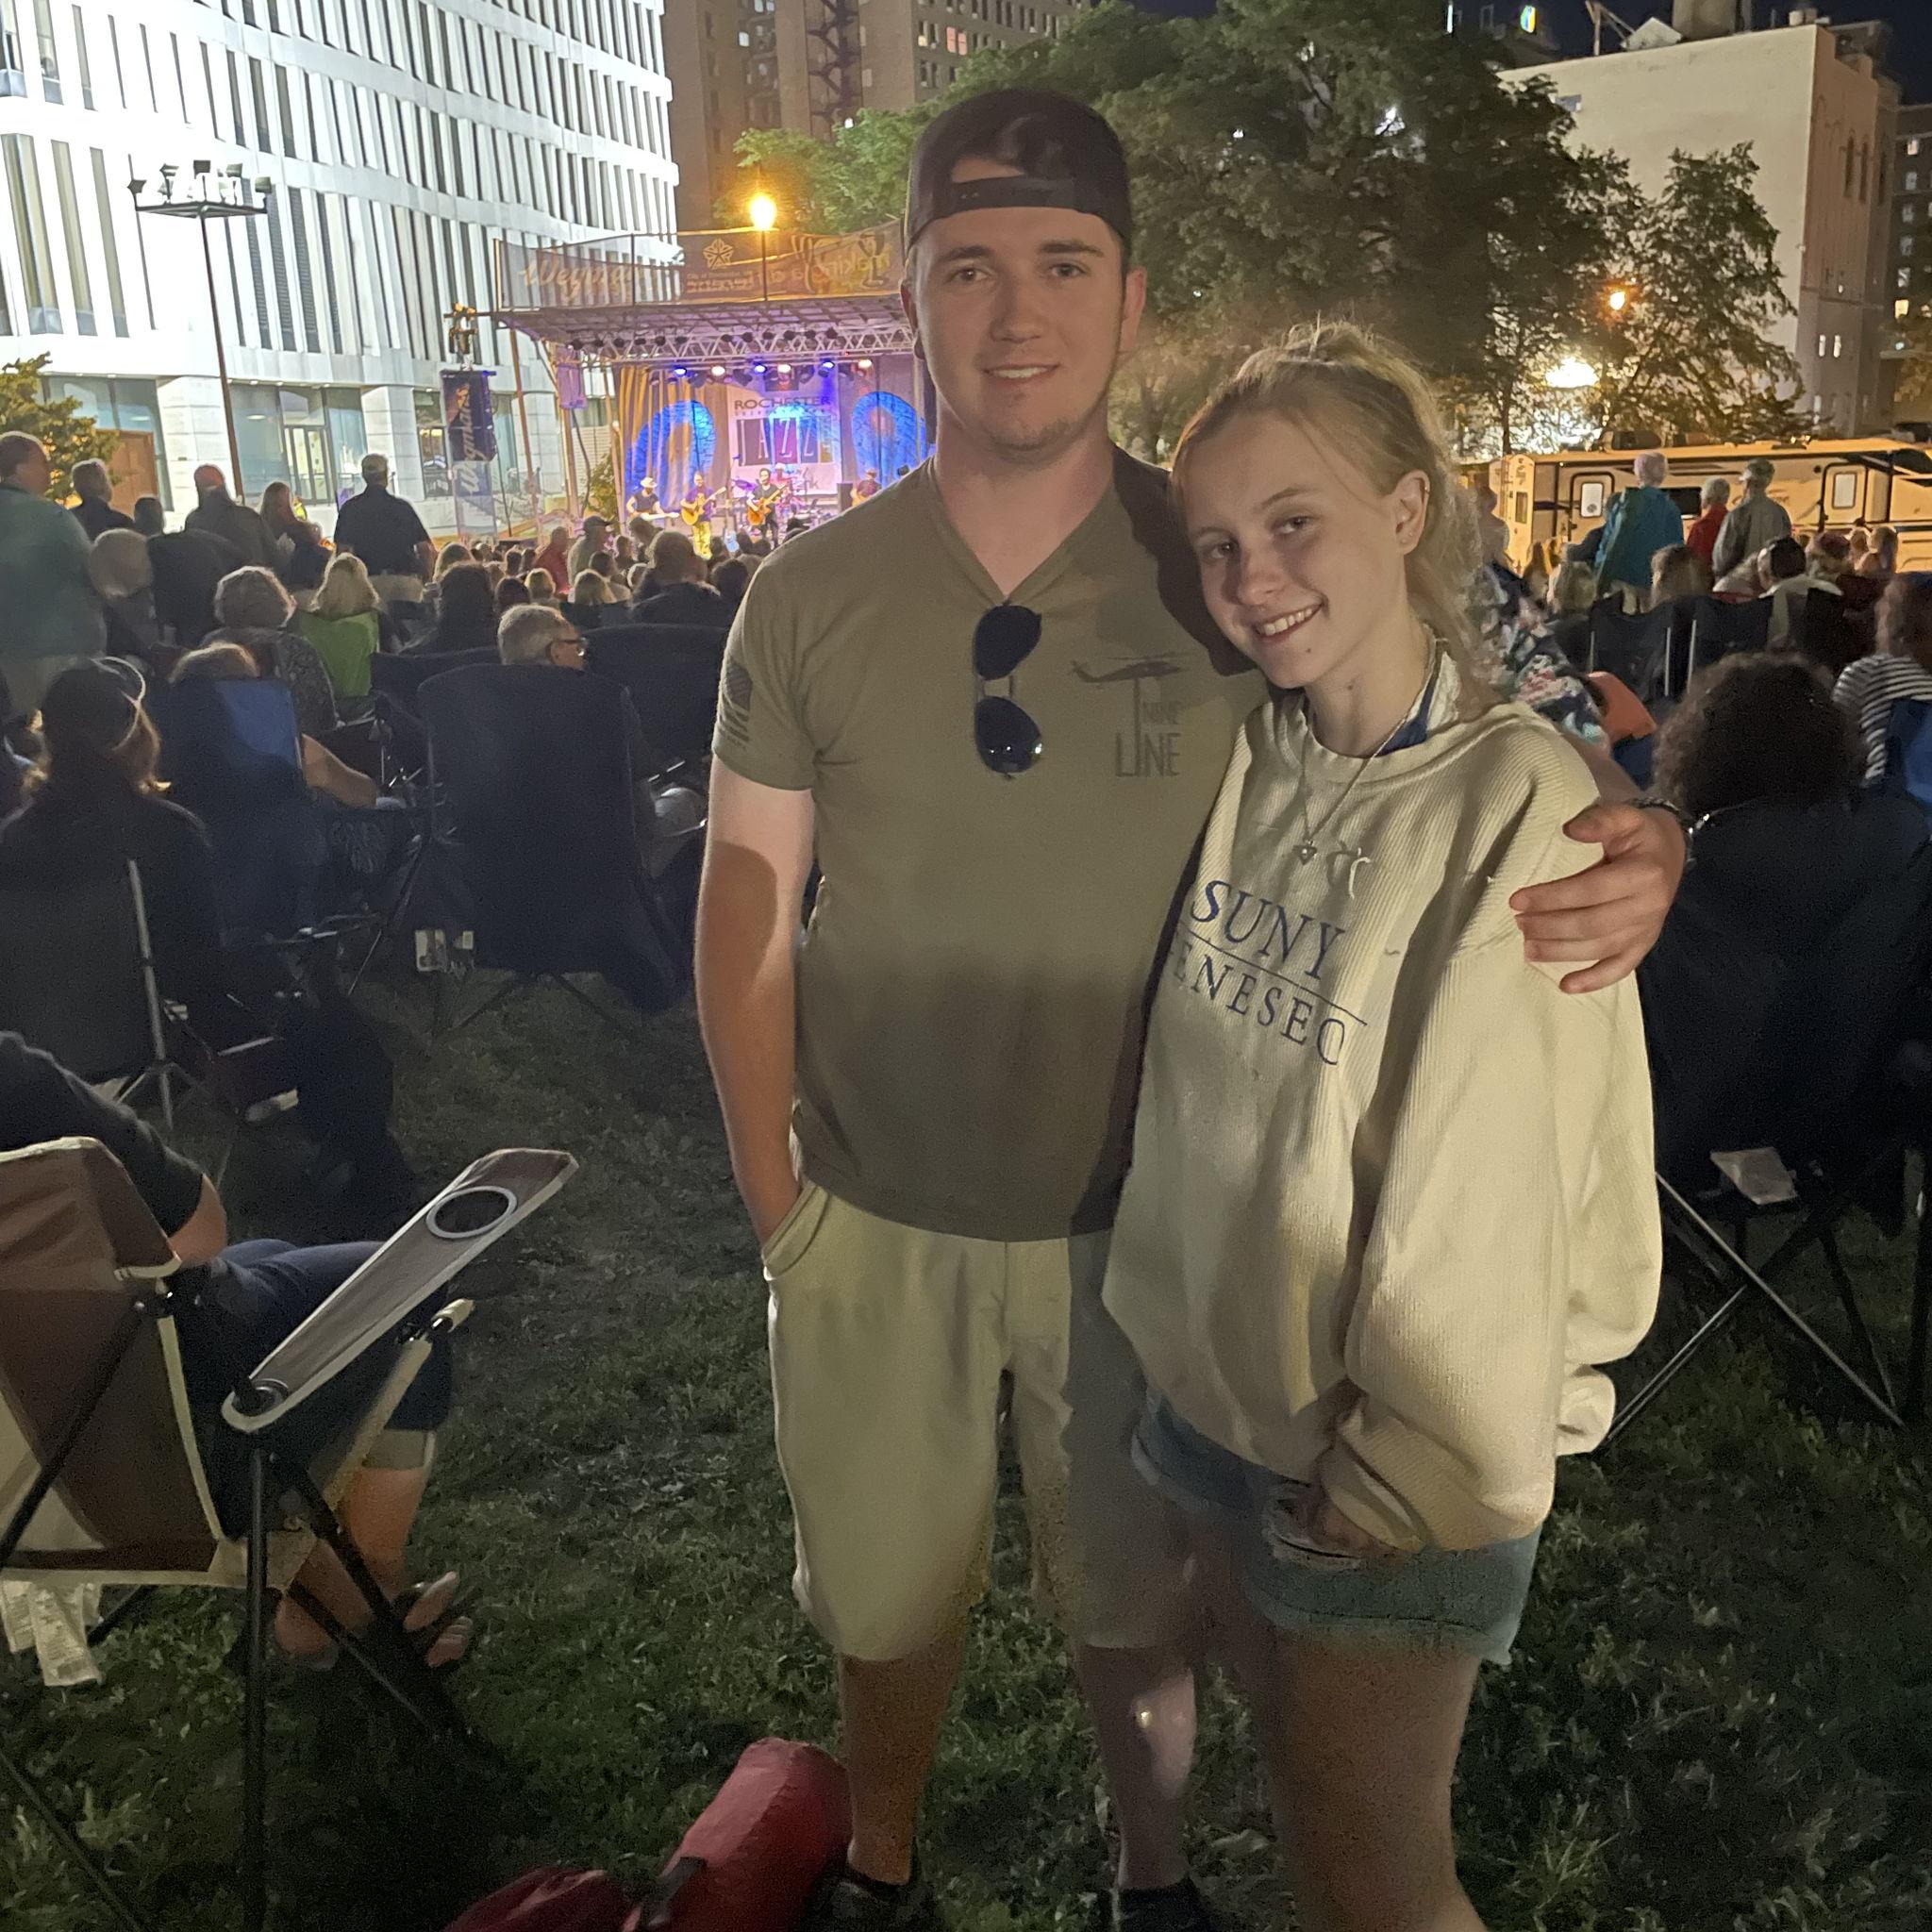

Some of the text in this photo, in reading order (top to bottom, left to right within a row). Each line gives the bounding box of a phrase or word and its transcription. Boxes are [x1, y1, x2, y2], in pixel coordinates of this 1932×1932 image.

[734, 395, 831, 409] ROCHESTER
[739, 417, 815, 466] JAZZ
[1190, 880, 1345, 980] SUNY
[1170, 934, 1346, 1066] ENESEO
